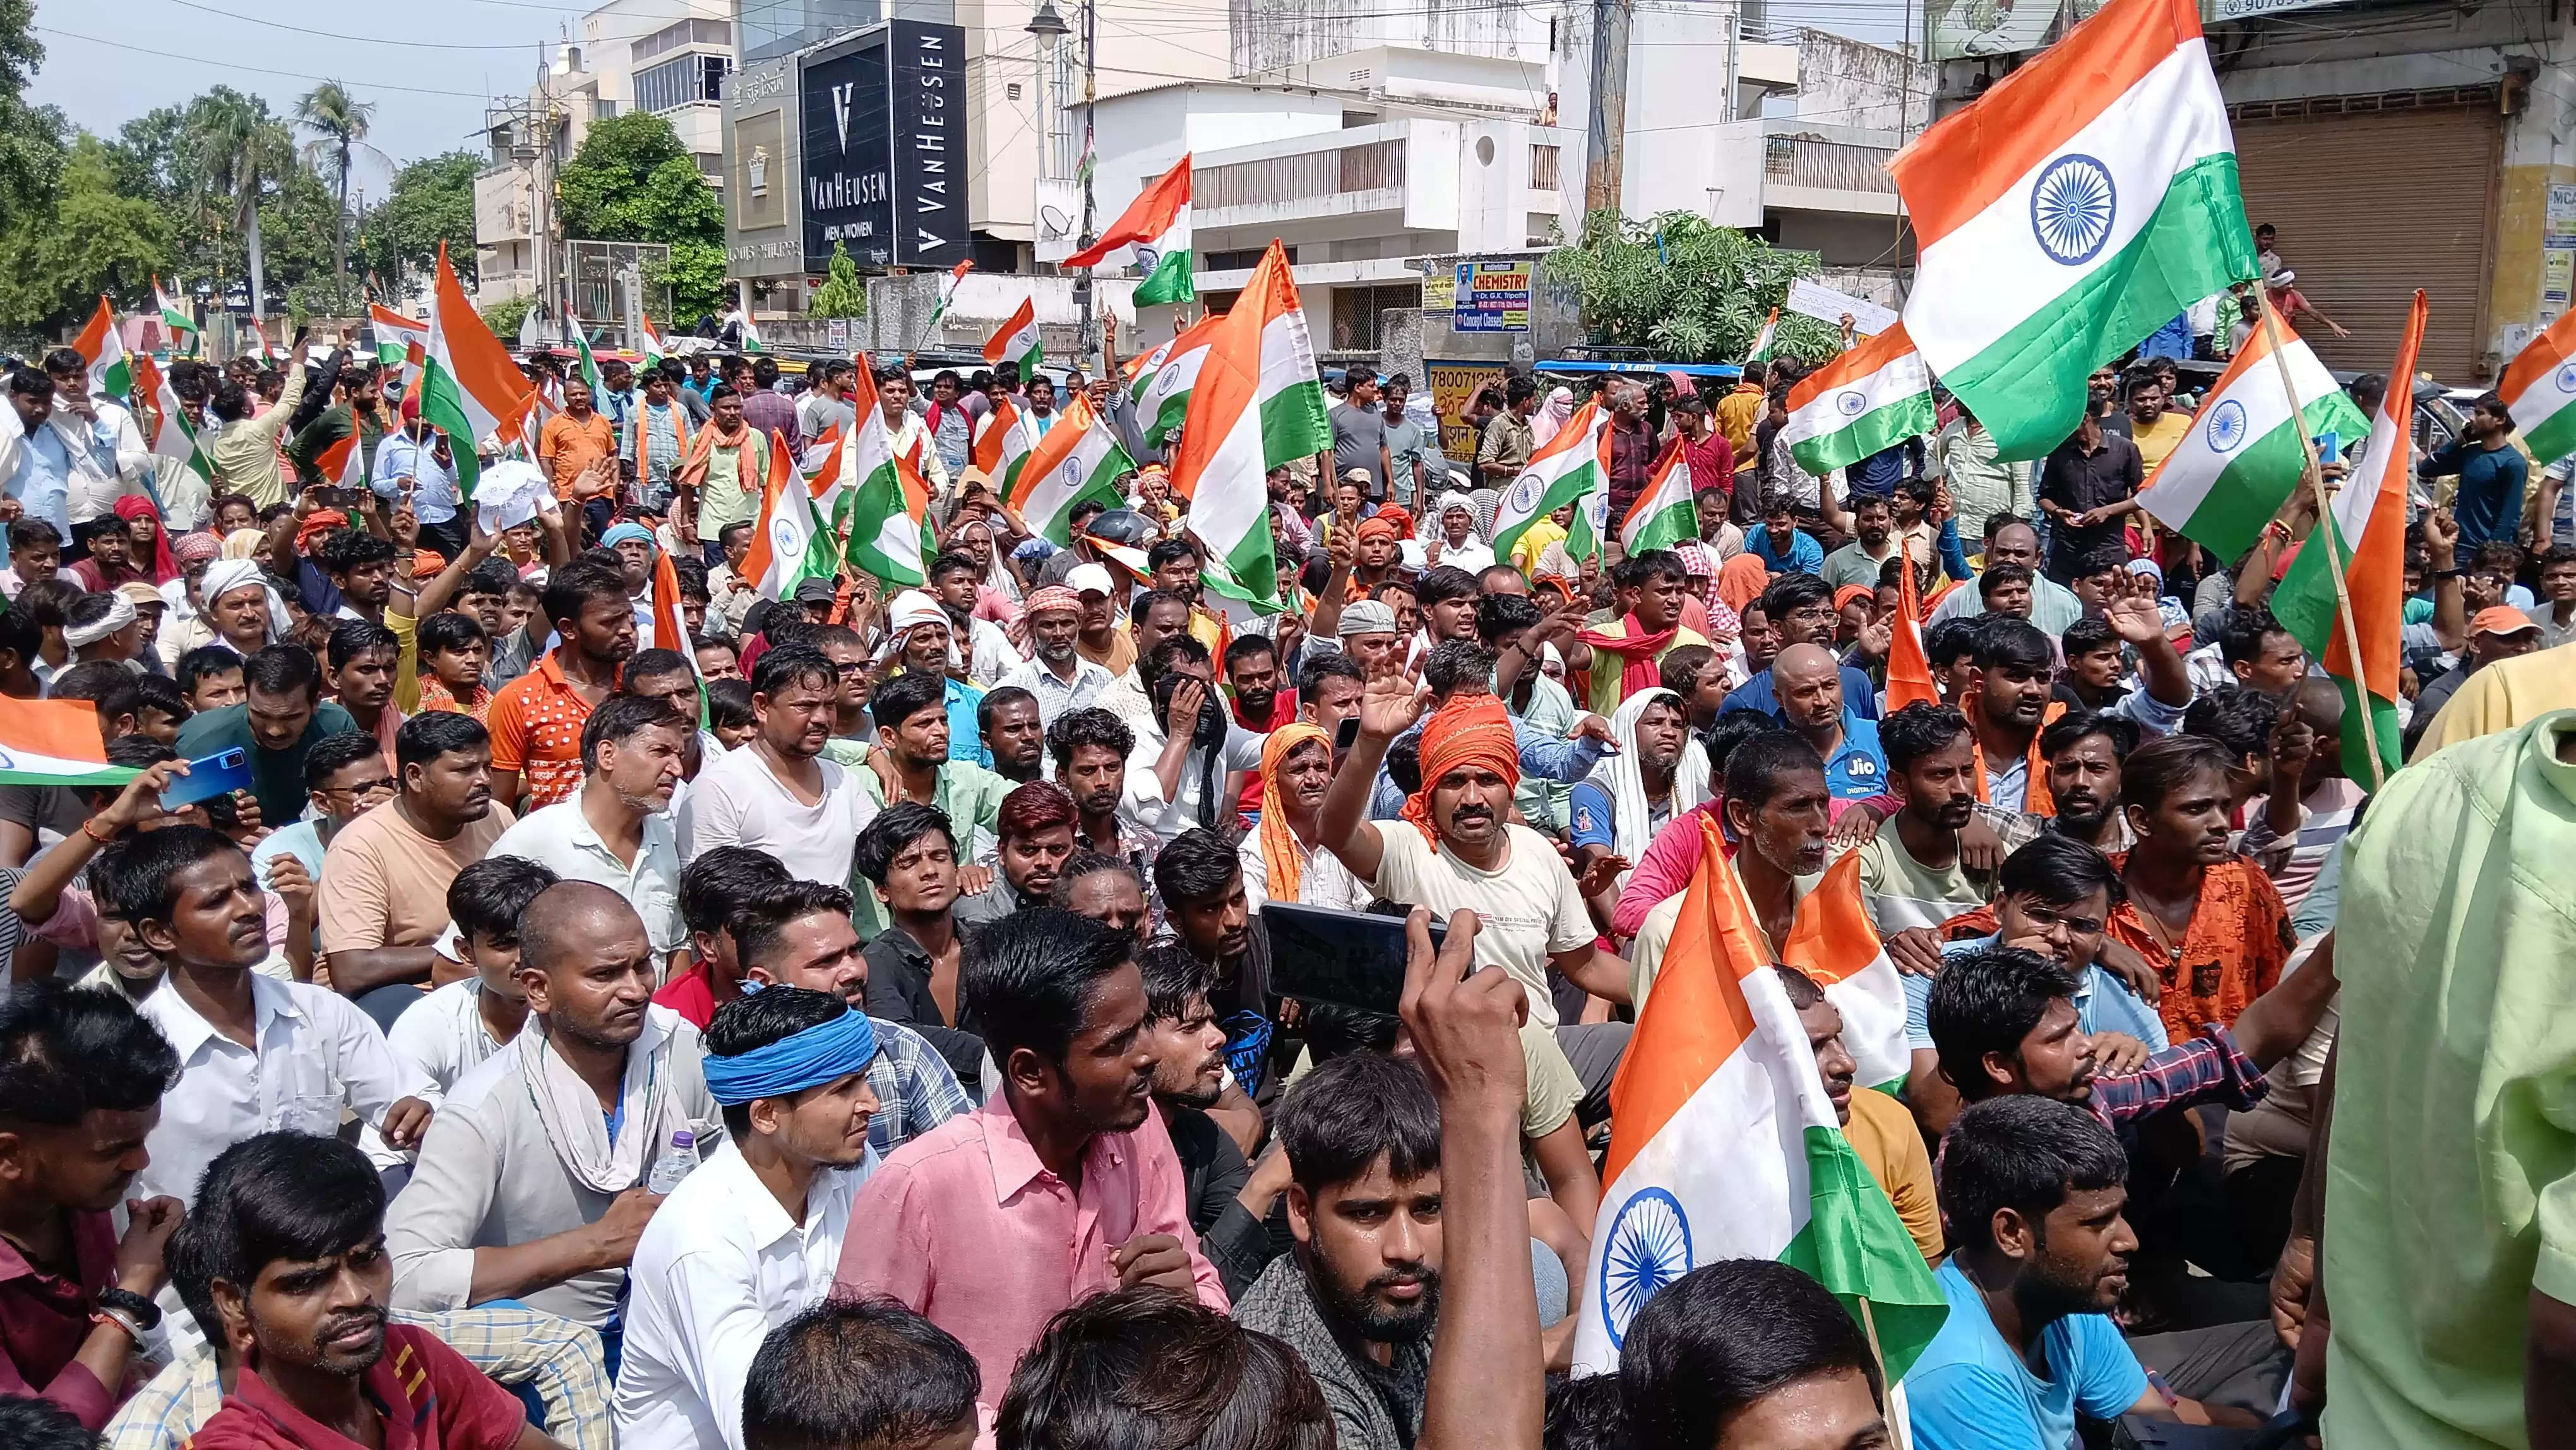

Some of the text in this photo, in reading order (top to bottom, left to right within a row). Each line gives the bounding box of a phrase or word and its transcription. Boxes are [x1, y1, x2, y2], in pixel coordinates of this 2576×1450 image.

[728, 240, 801, 263] LOUIS PHILIPPE
[1473, 273, 1529, 290] CHEMISTRY
[1464, 313, 1482, 330] Concept
[1483, 313, 1502, 327] Classes
[1849, 758, 1875, 776] Jio
